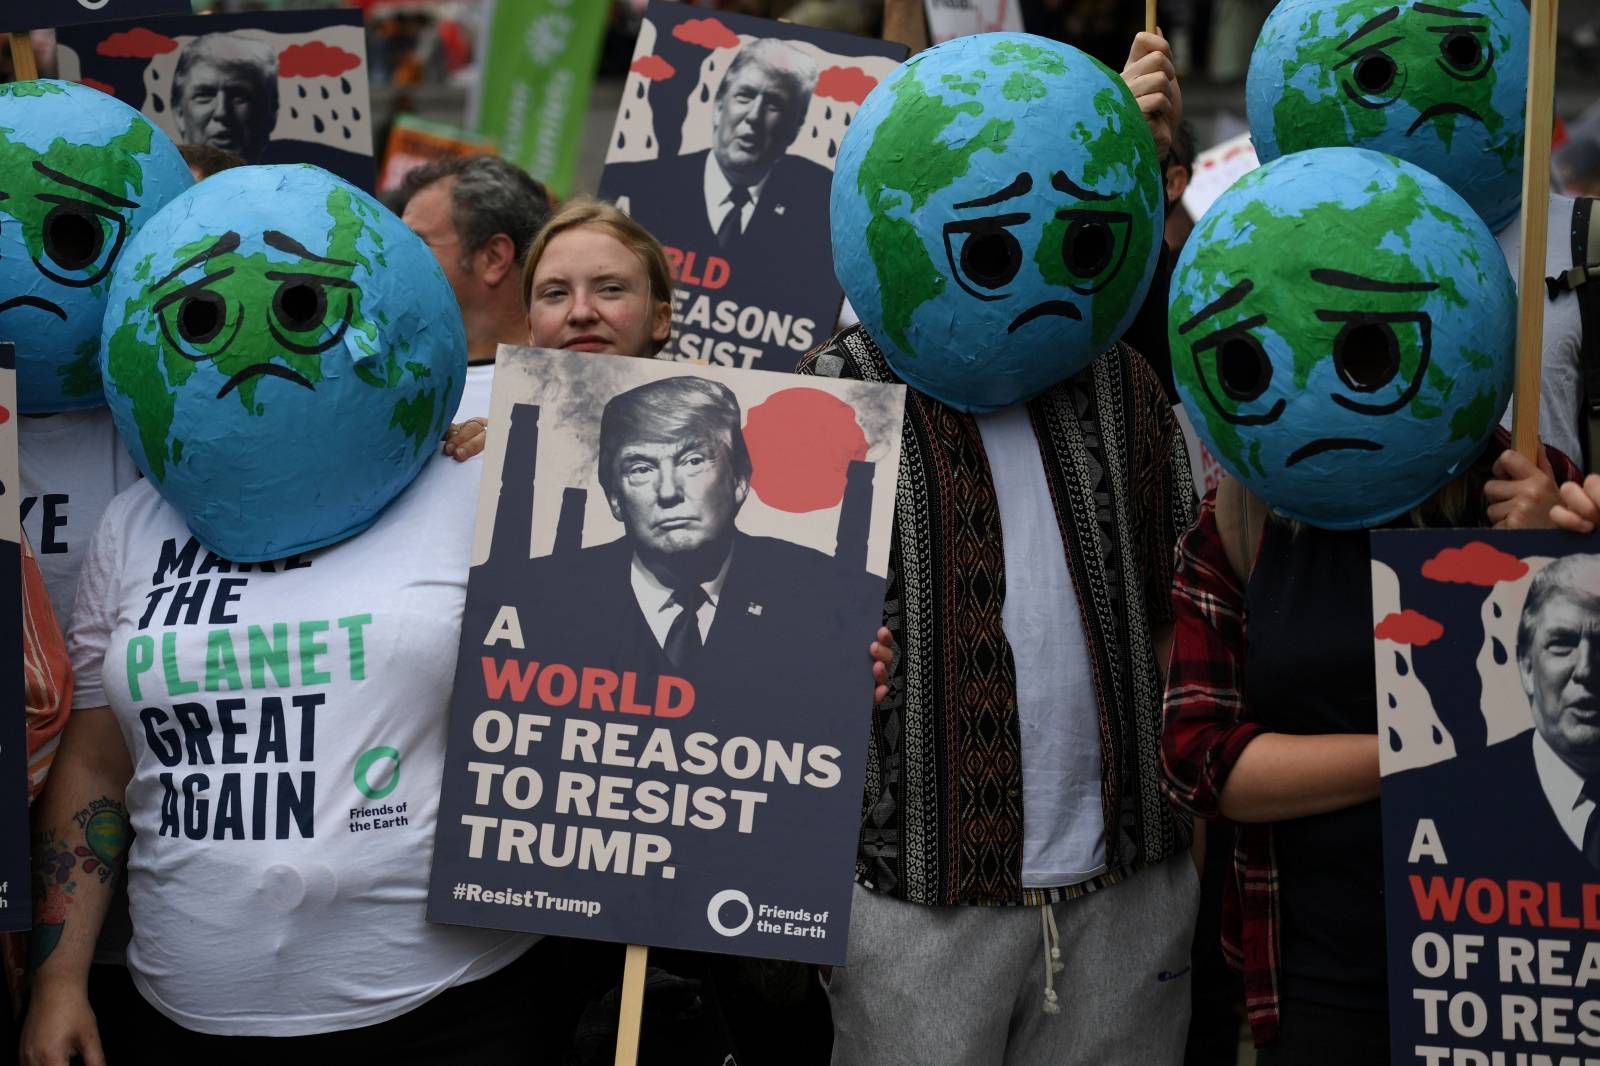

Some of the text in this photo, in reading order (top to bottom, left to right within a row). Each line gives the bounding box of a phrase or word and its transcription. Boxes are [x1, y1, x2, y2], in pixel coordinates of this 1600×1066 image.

[663, 246, 731, 290] RLD
[671, 287, 816, 352] EASONS
[138, 578, 248, 630] THE
[483, 605, 525, 649] A
[126, 613, 372, 702] PLANET
[481, 656, 696, 718] WORLD
[139, 693, 326, 767] GREAT
[472, 709, 842, 789] OF REASONS
[158, 771, 316, 840] AGAIN
[349, 801, 408, 819] Friends of
[467, 761, 768, 834] TO RESIST
[349, 815, 408, 832] the Earth
[461, 814, 676, 879] TRUMP.
[1408, 818, 1448, 864] A
[452, 883, 601, 918] #ResistTrump
[759, 904, 829, 924] Friends of
[757, 920, 826, 939] the Earth
[1411, 931, 1485, 980] OF
[1413, 988, 1488, 1038] TO
